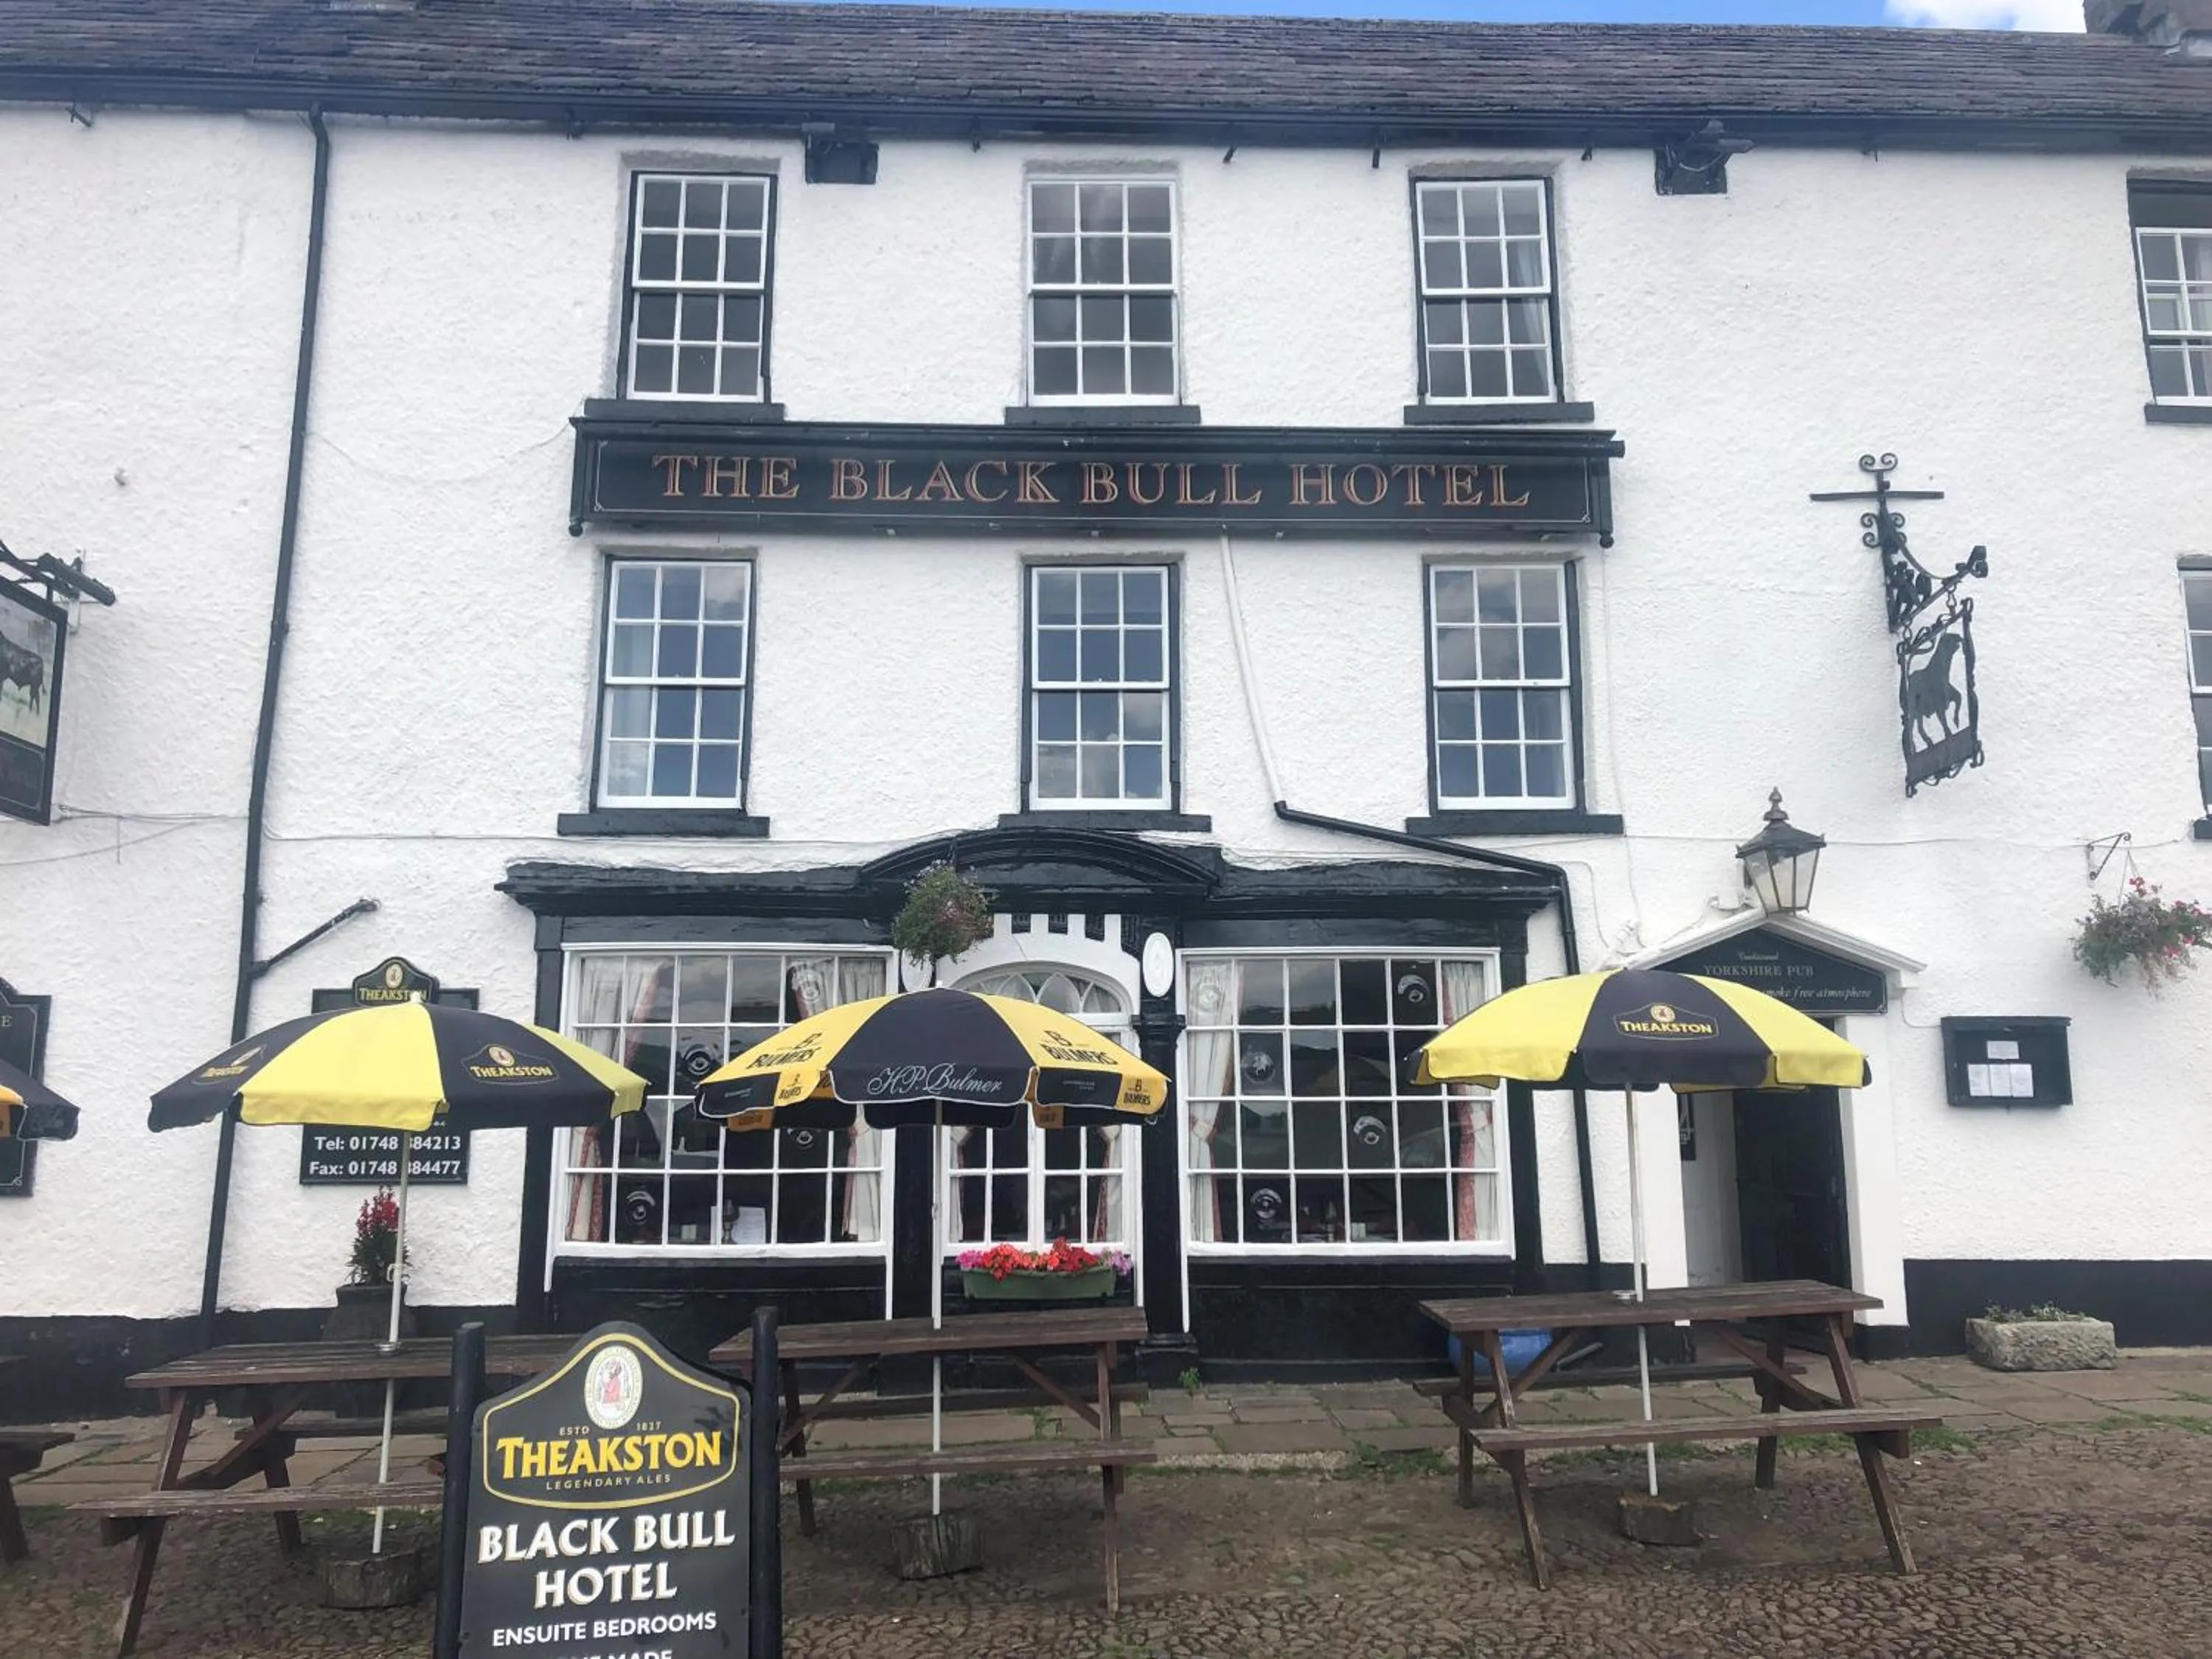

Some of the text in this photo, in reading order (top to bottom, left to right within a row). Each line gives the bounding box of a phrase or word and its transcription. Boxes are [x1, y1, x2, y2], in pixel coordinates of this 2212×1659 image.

[652, 454, 1531, 507] THE BLACK BULL HOTEL
[1703, 965, 1815, 978] YORKSHIRE PUB
[359, 987, 428, 1001] THEAKSTN
[1619, 1020, 1713, 1034] THEAKSTON
[469, 1065, 554, 1078] THEAKSTON
[922, 1062, 1003, 1095] Bulmer
[314, 1136, 345, 1150] Tel:
[349, 1135, 399, 1150] 01748
[309, 1161, 461, 1175] Fax: 01748 84477
[559, 1421, 661, 1436] ESTD 1827
[495, 1430, 722, 1480] THEAKSTON
[546, 1474, 671, 1491] LEGENDARY ALES
[478, 1509, 736, 1565] BLACK BULL
[533, 1561, 678, 1610] HOTEL
[492, 1612, 717, 1646] ENSUITE BEDROOMS
